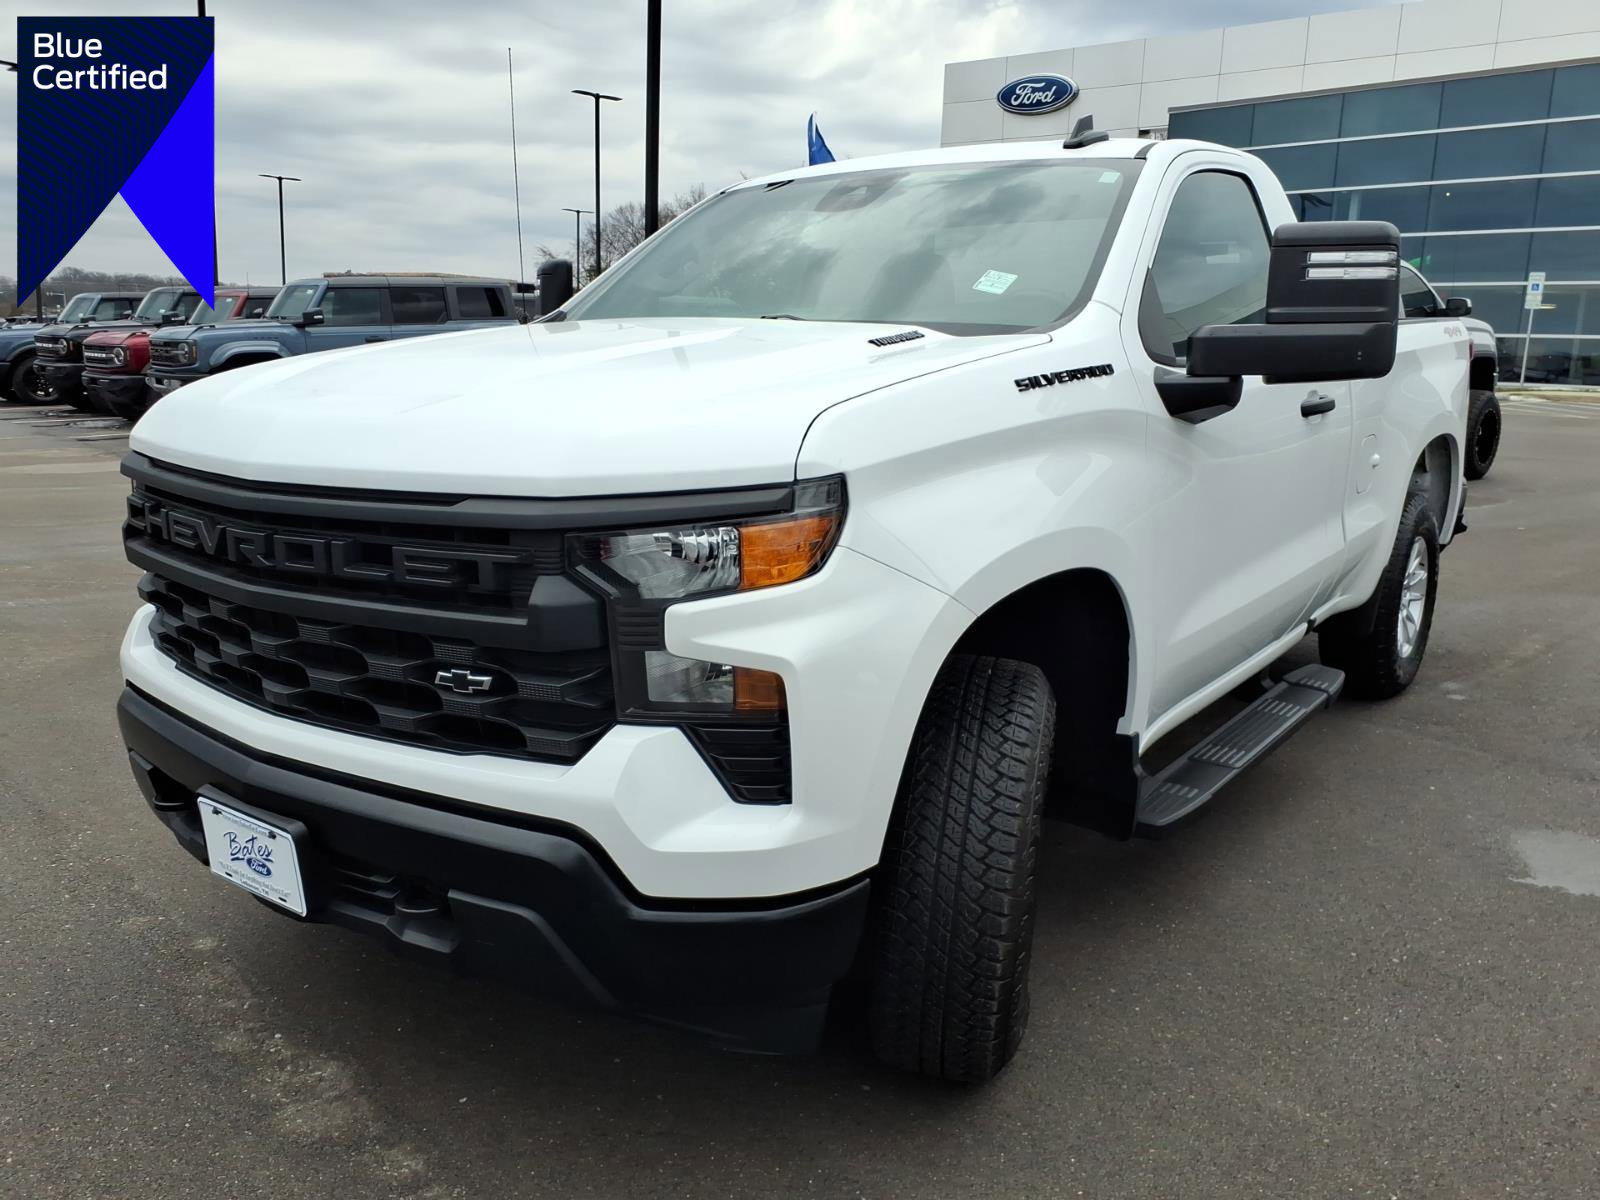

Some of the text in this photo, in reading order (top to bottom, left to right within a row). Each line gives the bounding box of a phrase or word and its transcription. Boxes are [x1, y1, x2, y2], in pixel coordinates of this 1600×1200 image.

[1011, 82, 1057, 106] Ford
[1014, 363, 1115, 392] SILVERADO
[127, 494, 530, 592] CHEVROLET
[223, 831, 273, 858] Bates
[249, 859, 269, 876] Ford
